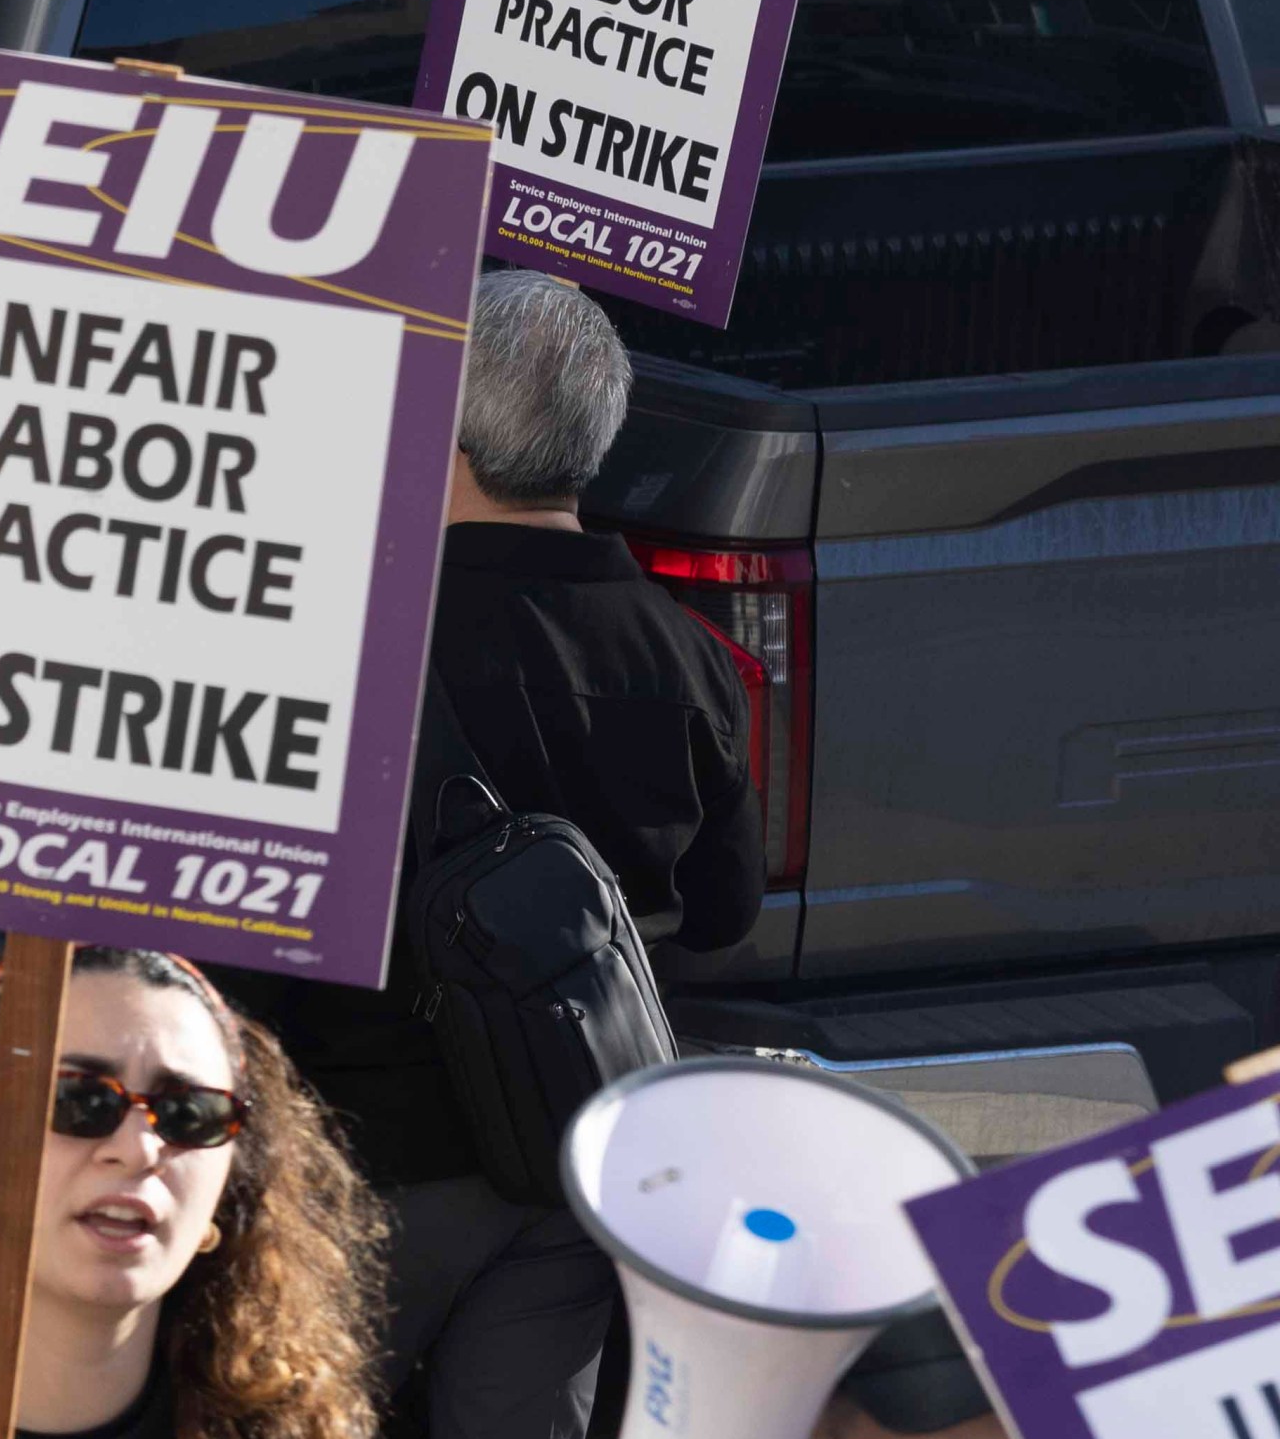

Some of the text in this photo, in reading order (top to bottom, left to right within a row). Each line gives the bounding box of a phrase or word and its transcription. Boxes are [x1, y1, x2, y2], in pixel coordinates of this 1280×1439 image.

[452, 71, 716, 201] ON STRIKE
[501, 196, 700, 279] LOCAL 1021
[509, 179, 704, 247] Service Employees International Union
[7, 802, 114, 831] Employees
[123, 820, 256, 853] International
[264, 841, 325, 863] Union
[173, 856, 320, 916] 1021
